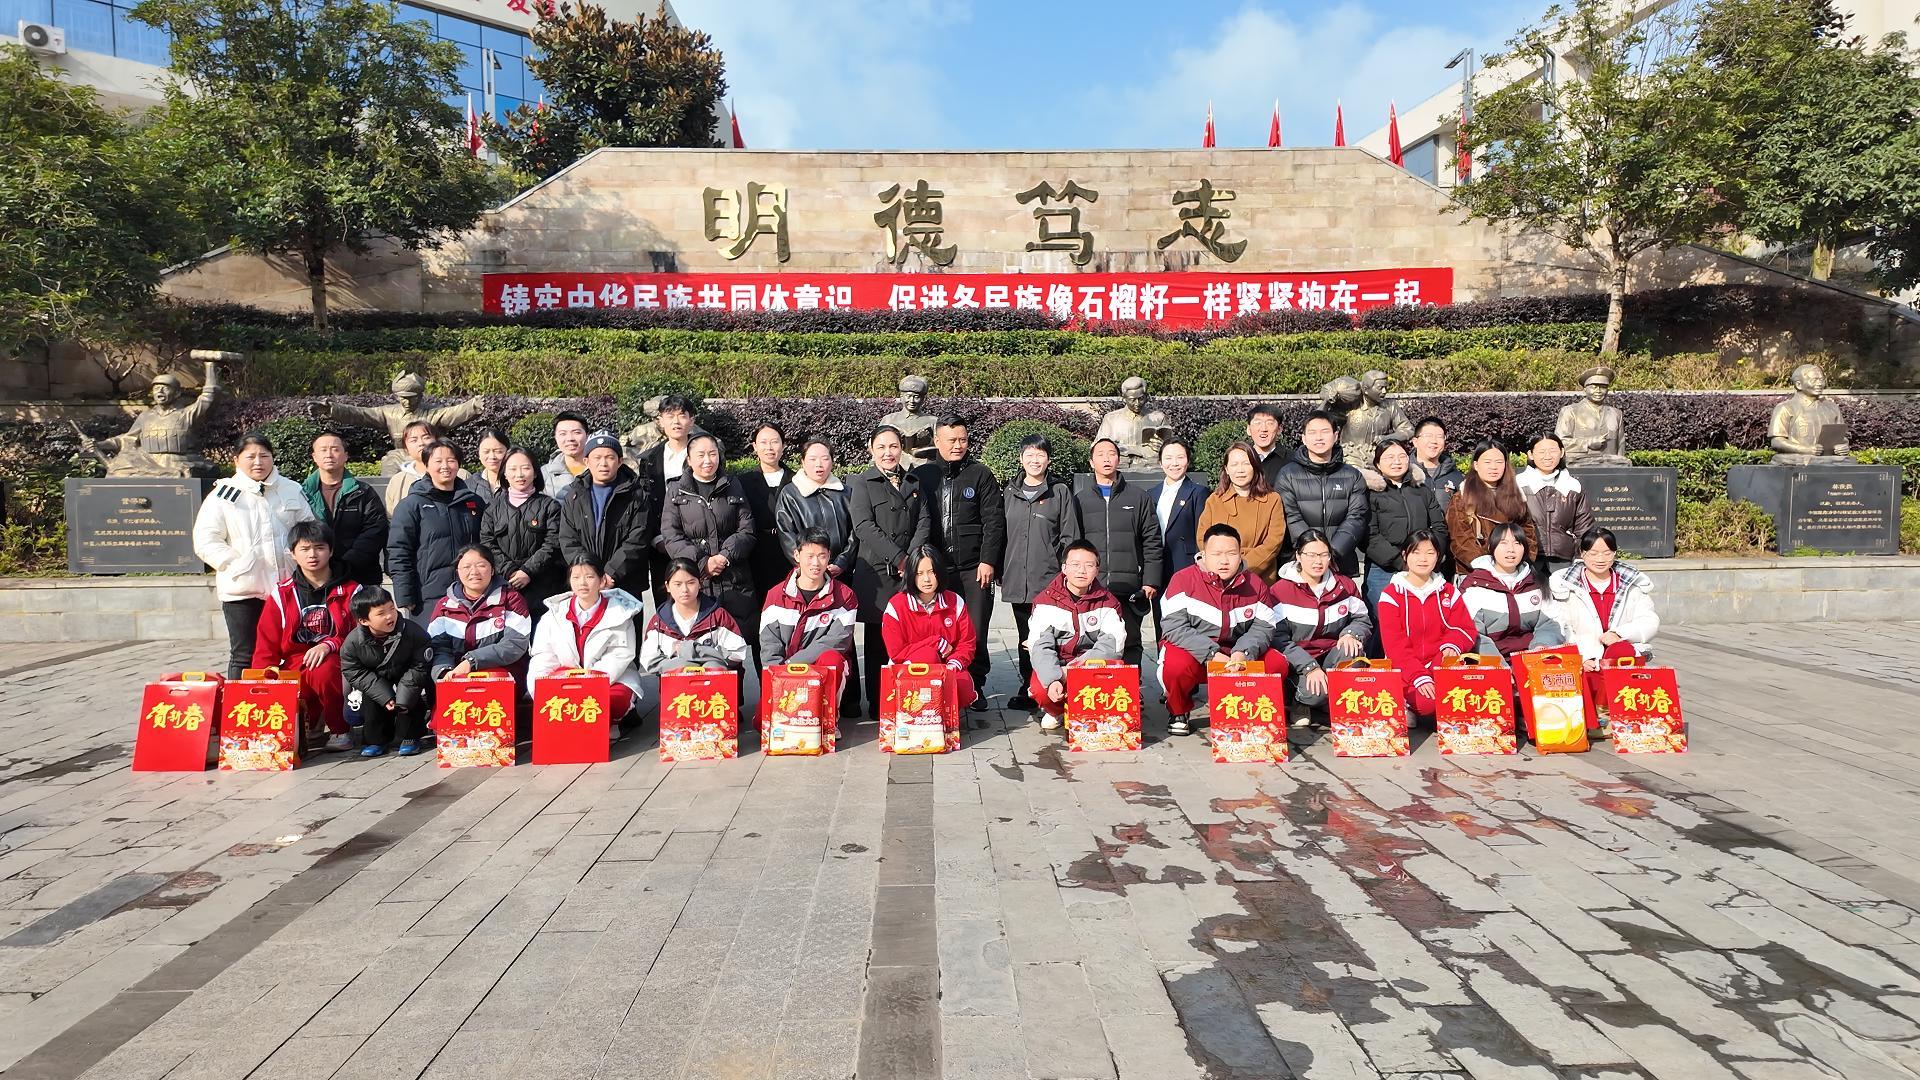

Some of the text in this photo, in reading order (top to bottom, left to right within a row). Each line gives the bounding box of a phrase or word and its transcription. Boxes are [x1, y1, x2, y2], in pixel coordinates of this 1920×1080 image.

[703, 178, 1248, 266] 明德笃志
[442, 698, 507, 727] 贺新春
[539, 695, 603, 724] 贺新春
[667, 691, 731, 720] 贺新春
[1074, 684, 1133, 712] 贺新春
[1216, 693, 1278, 722] 贺新春
[1336, 687, 1398, 717] 贺新春
[1441, 685, 1506, 715] 贺新春
[1614, 685, 1673, 714] 贺新春
[145, 701, 205, 731] 贺新春
[227, 700, 289, 731] 贺新春
